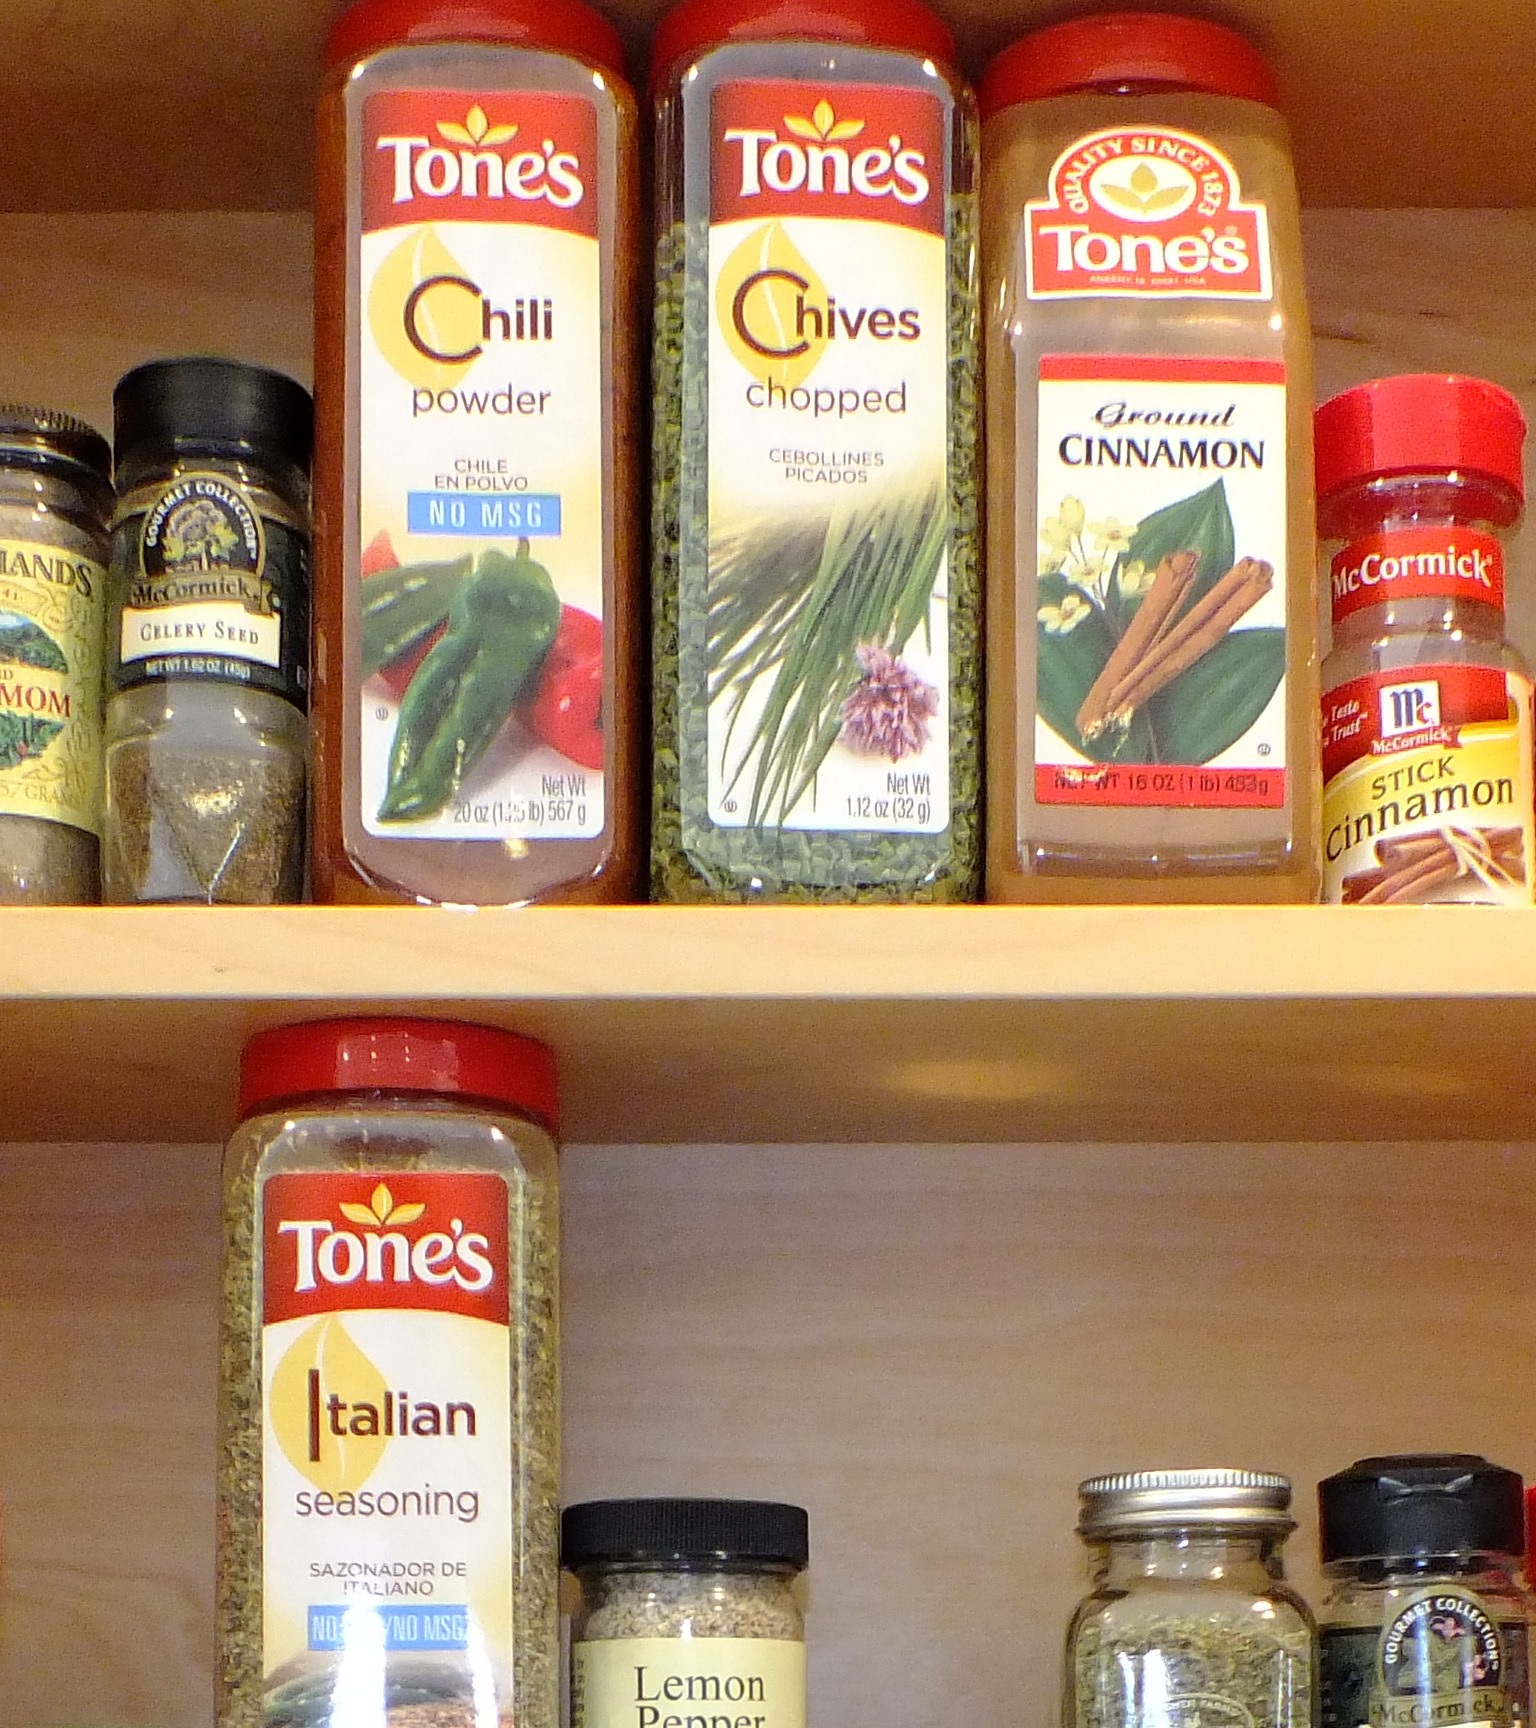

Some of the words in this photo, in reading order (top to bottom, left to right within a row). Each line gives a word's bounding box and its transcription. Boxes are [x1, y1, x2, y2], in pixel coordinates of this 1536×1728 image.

[376, 137, 585, 208] Tone's
[724, 129, 930, 207] Tone's
[1065, 138, 1123, 214] QUALITY
[1039, 224, 1250, 275] Tone's
[403, 274, 554, 365] Chili
[731, 269, 921, 359] Chives
[412, 383, 552, 418] powder
[745, 376, 907, 418] chopped
[1094, 400, 1237, 429] Ground
[453, 458, 508, 474] CHILE
[768, 448, 884, 467] CEBOLLINES
[1058, 434, 1265, 470] CINNAMON
[434, 475, 460, 489] EN
[464, 475, 529, 491] POLVO
[784, 467, 868, 484] PICADOS
[428, 500, 466, 527] NO
[481, 500, 543, 528] MSG
[1332, 544, 1491, 599] McCormick
[1372, 725, 1452, 755] McCormick
[541, 774, 571, 796] Net
[886, 773, 915, 795] Net
[1371, 755, 1455, 800] STICK
[1325, 776, 1514, 862] Cinnamon
[277, 1217, 493, 1293] Tone's
[307, 1368, 477, 1462] Italian
[295, 1483, 479, 1523] seasoning
[309, 1561, 437, 1578] SAZONADOR
[441, 1561, 467, 1577] DE
[423, 1614, 463, 1642] MSG
[1384, 1600, 1432, 1665] GOURMET
[1436, 1597, 1500, 1661] COLLECTION
[634, 1666, 766, 1702] Lemon
